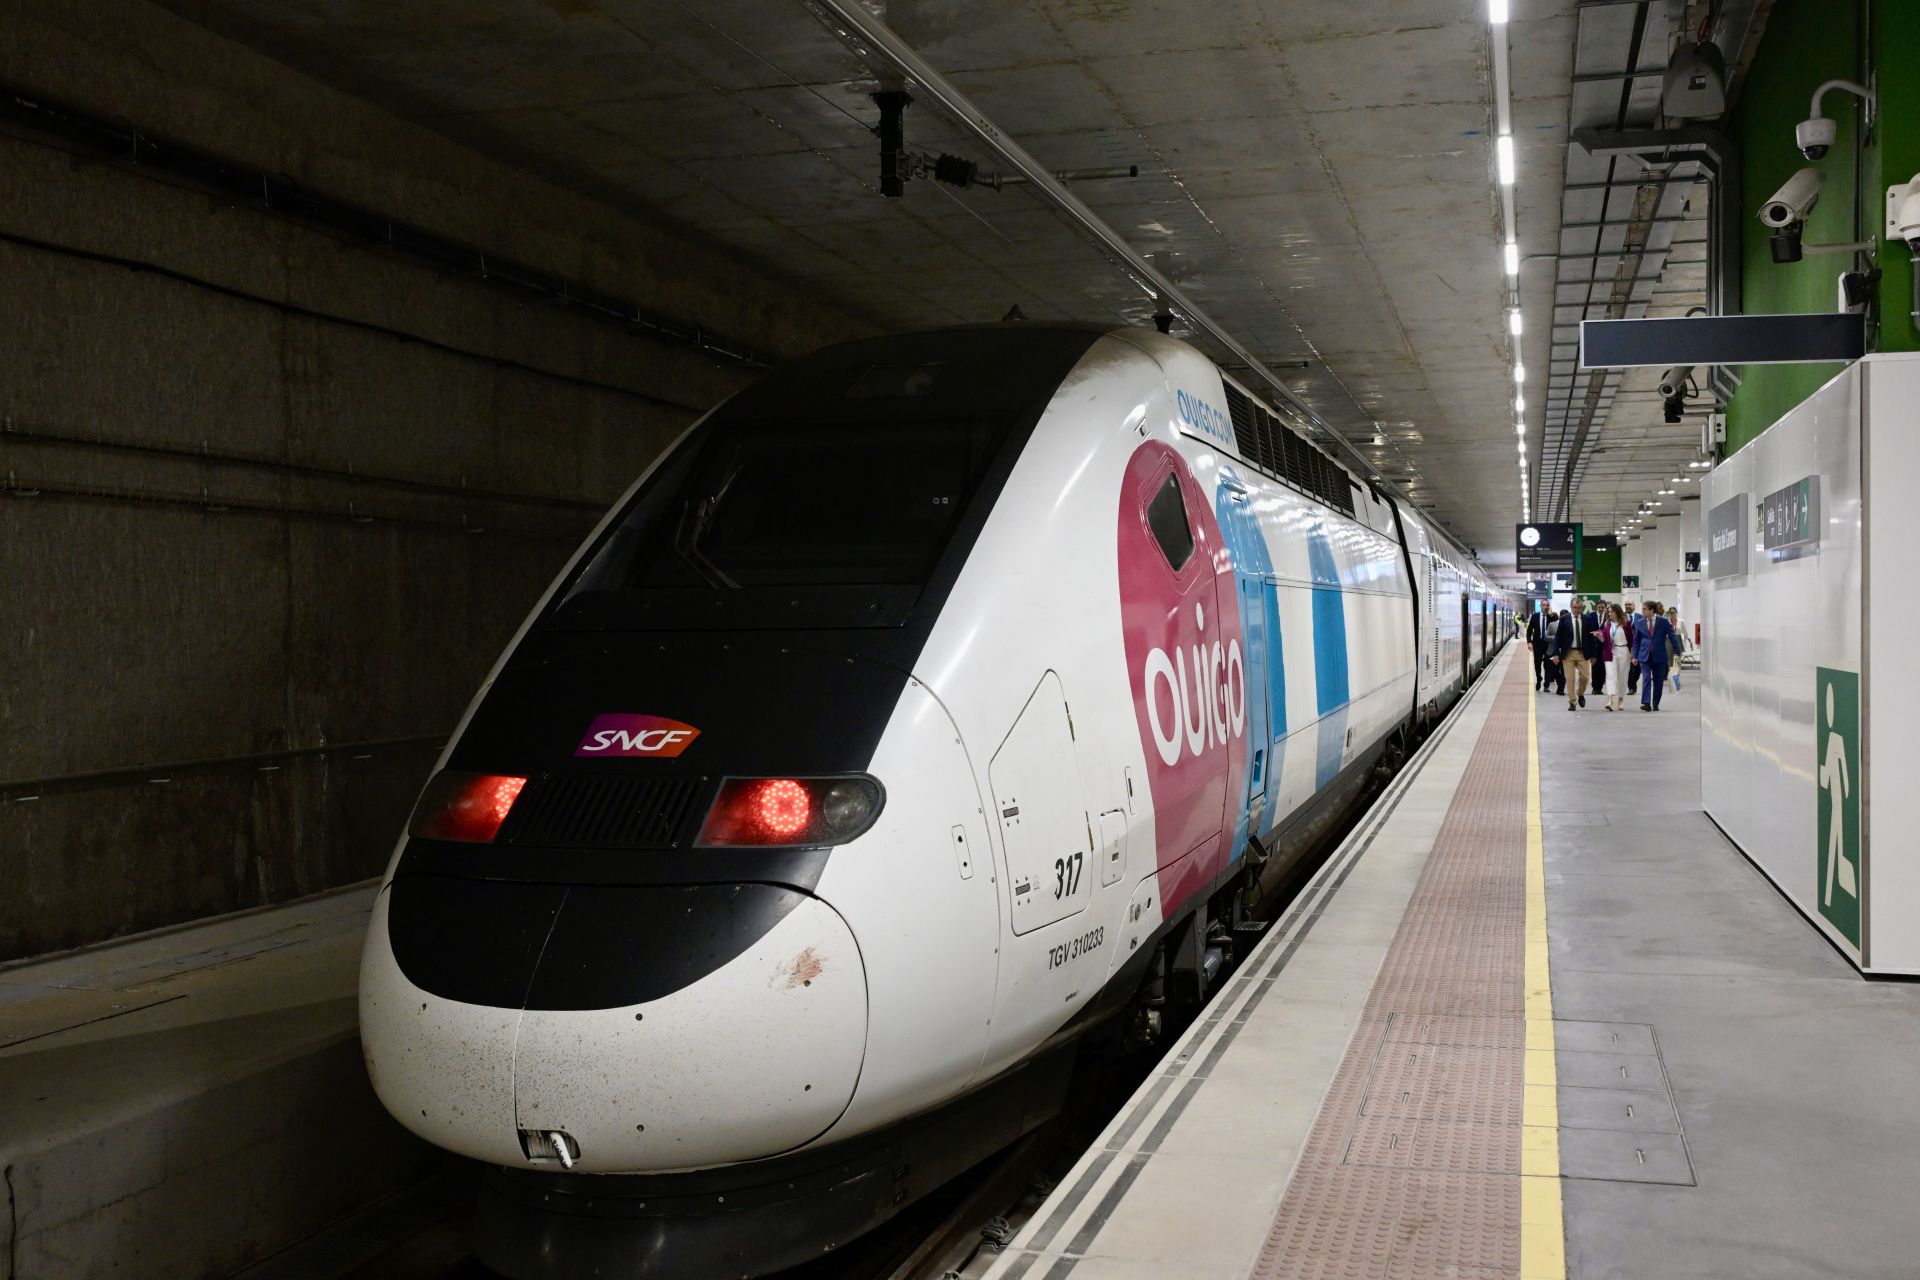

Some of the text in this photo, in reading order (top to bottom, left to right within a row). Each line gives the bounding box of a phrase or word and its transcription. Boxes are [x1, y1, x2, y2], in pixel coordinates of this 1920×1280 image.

[1567, 534, 1574, 544] 4
[1687, 561, 1694, 571] 4
[582, 730, 692, 751] SNCF
[1054, 852, 1083, 900] 317
[1049, 926, 1104, 970] TGV 310233
